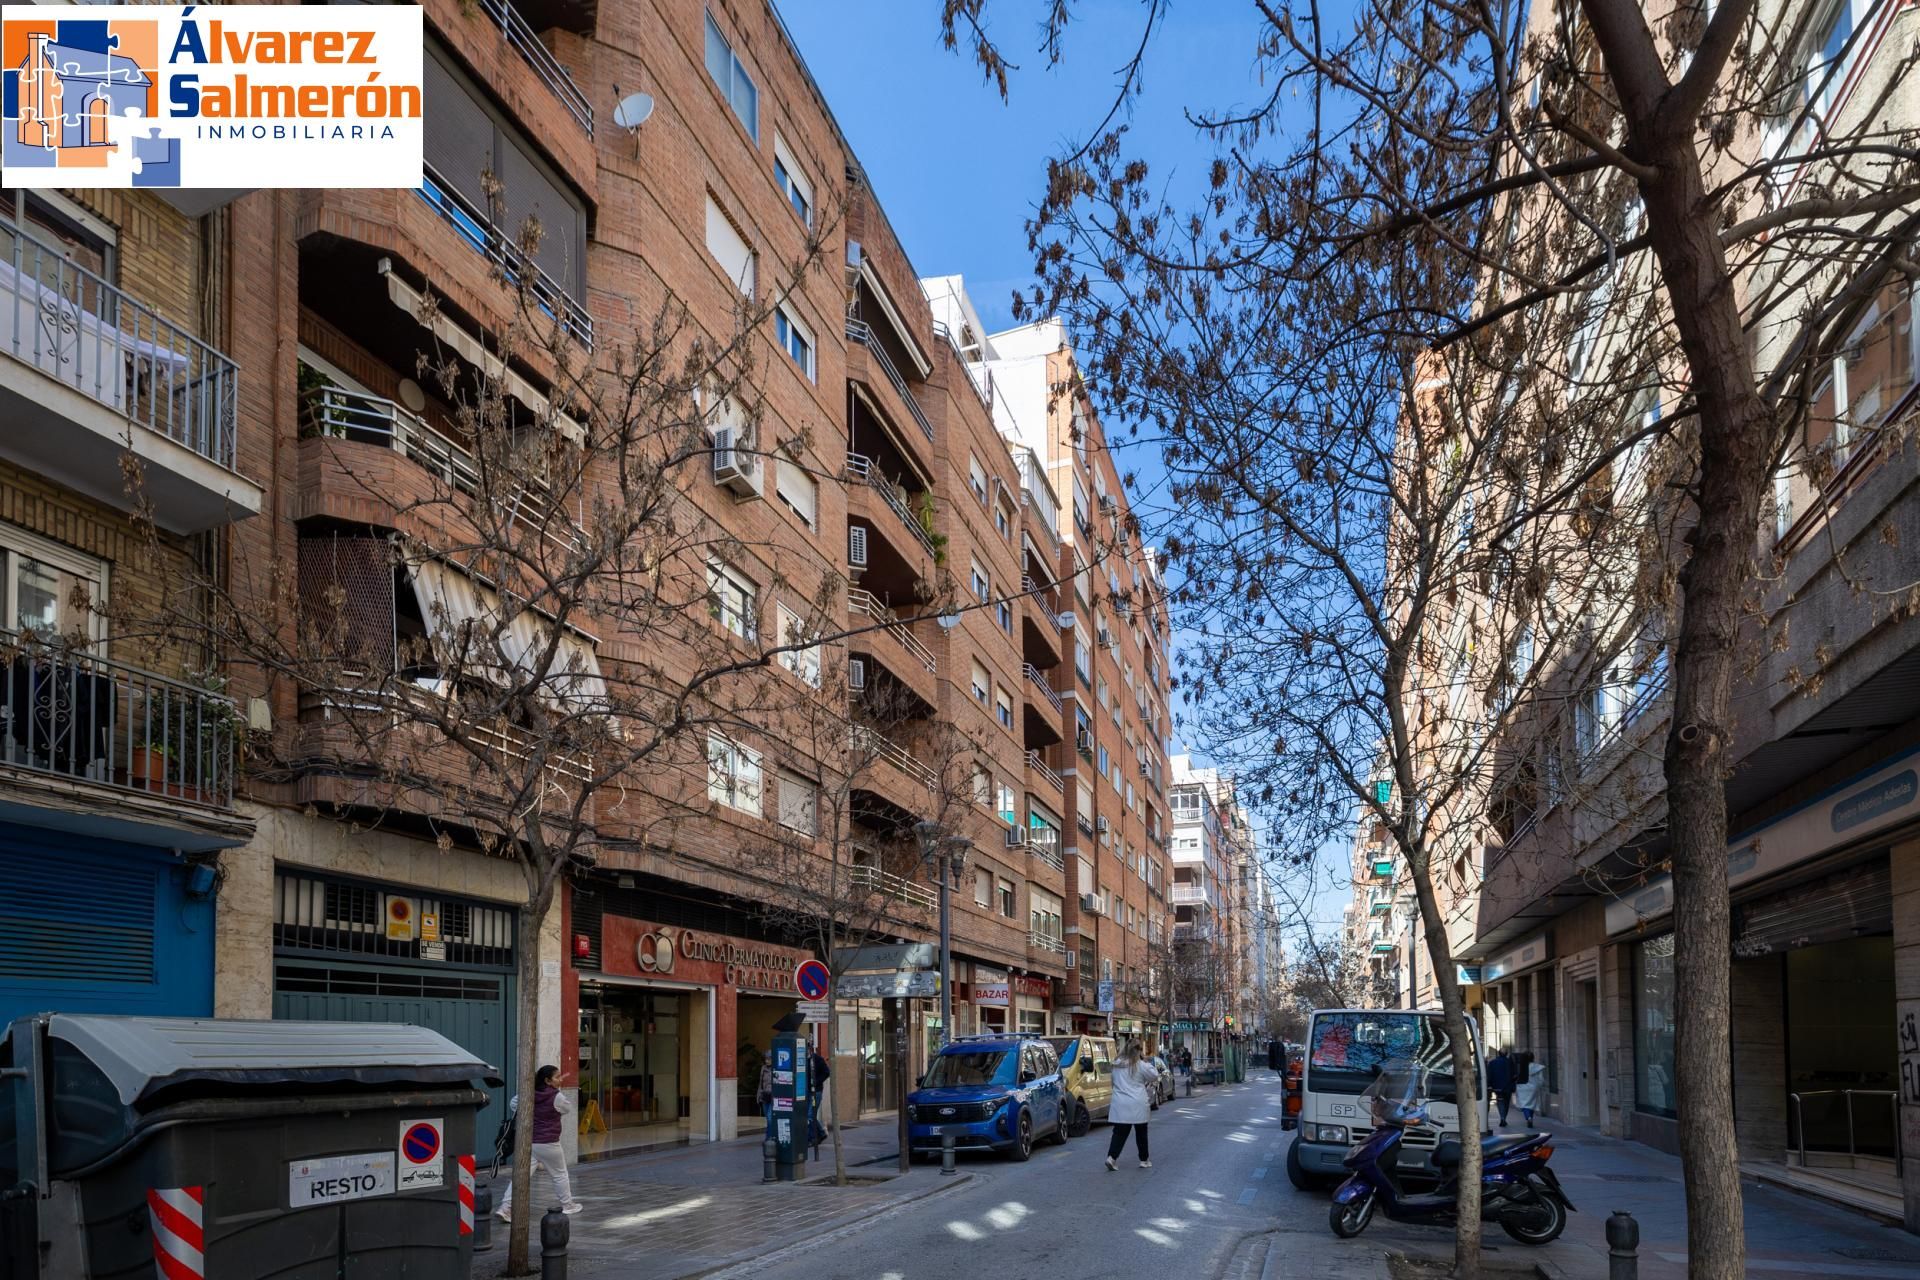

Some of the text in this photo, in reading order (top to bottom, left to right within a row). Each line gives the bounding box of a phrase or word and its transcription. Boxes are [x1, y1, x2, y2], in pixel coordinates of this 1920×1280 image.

[726, 963, 796, 990] GRANAD
[976, 989, 1008, 999] BAZAR
[778, 1051, 790, 1067] P
[310, 1174, 377, 1199] RESTO
